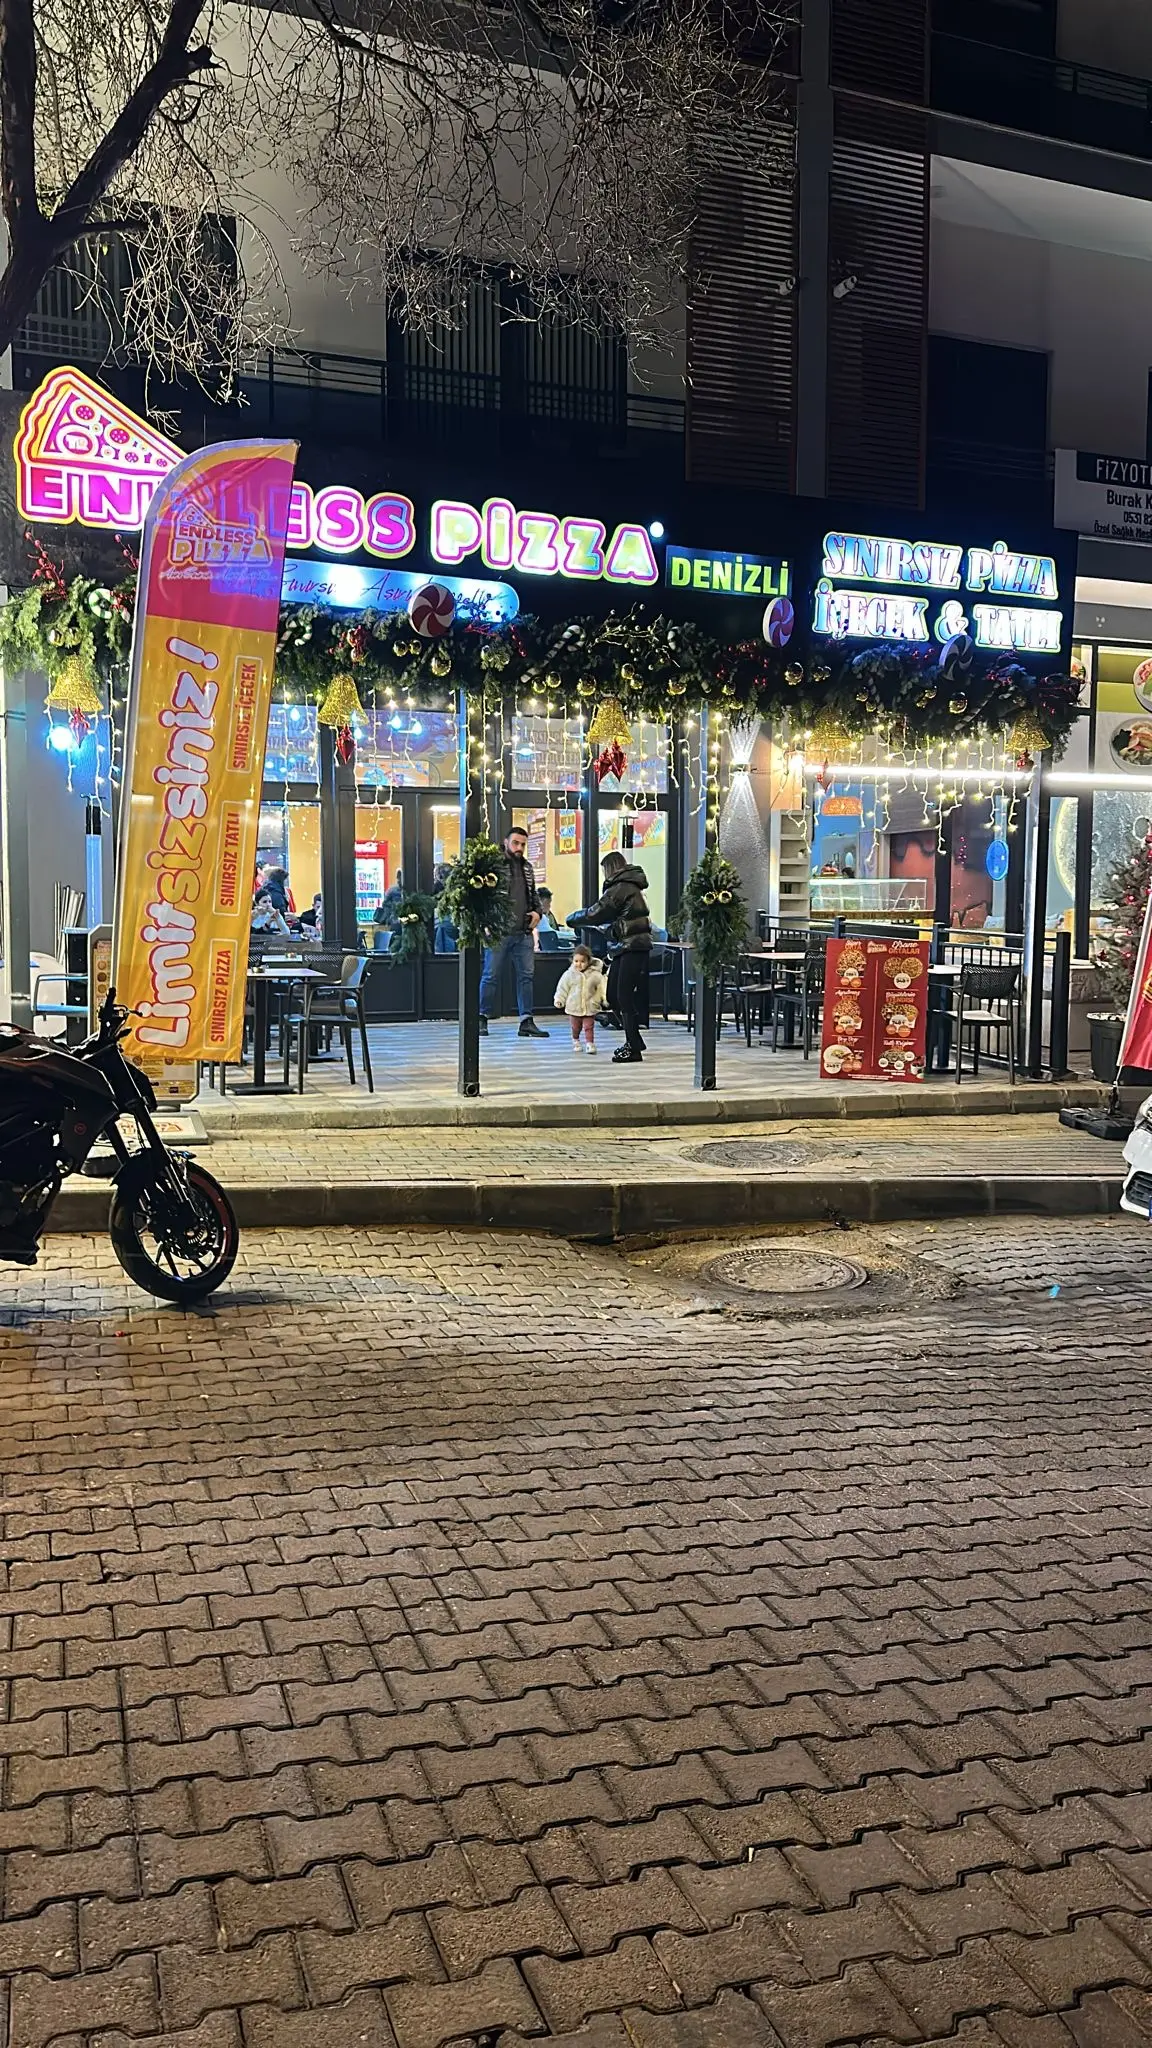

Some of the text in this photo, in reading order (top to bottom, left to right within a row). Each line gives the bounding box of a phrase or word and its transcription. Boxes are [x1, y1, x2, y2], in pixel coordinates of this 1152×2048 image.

[1096, 459, 1152, 485] FİZYOT
[1106, 489, 1142, 509] Burak
[179, 525, 254, 546] ENDLESS
[431, 498, 659, 586] PİZZA
[823, 531, 1060, 600] SINIRSIZ PİZZA
[671, 556, 789, 595] DENİZLİ
[812, 578, 1063, 652] İÇECEK & TATLI
[232, 663, 256, 769] SINIRSIZ İÇECEK
[220, 812, 241, 907] SINIRSIZ TATLI
[210, 949, 232, 1042] SINIRSIZ PİZZA
